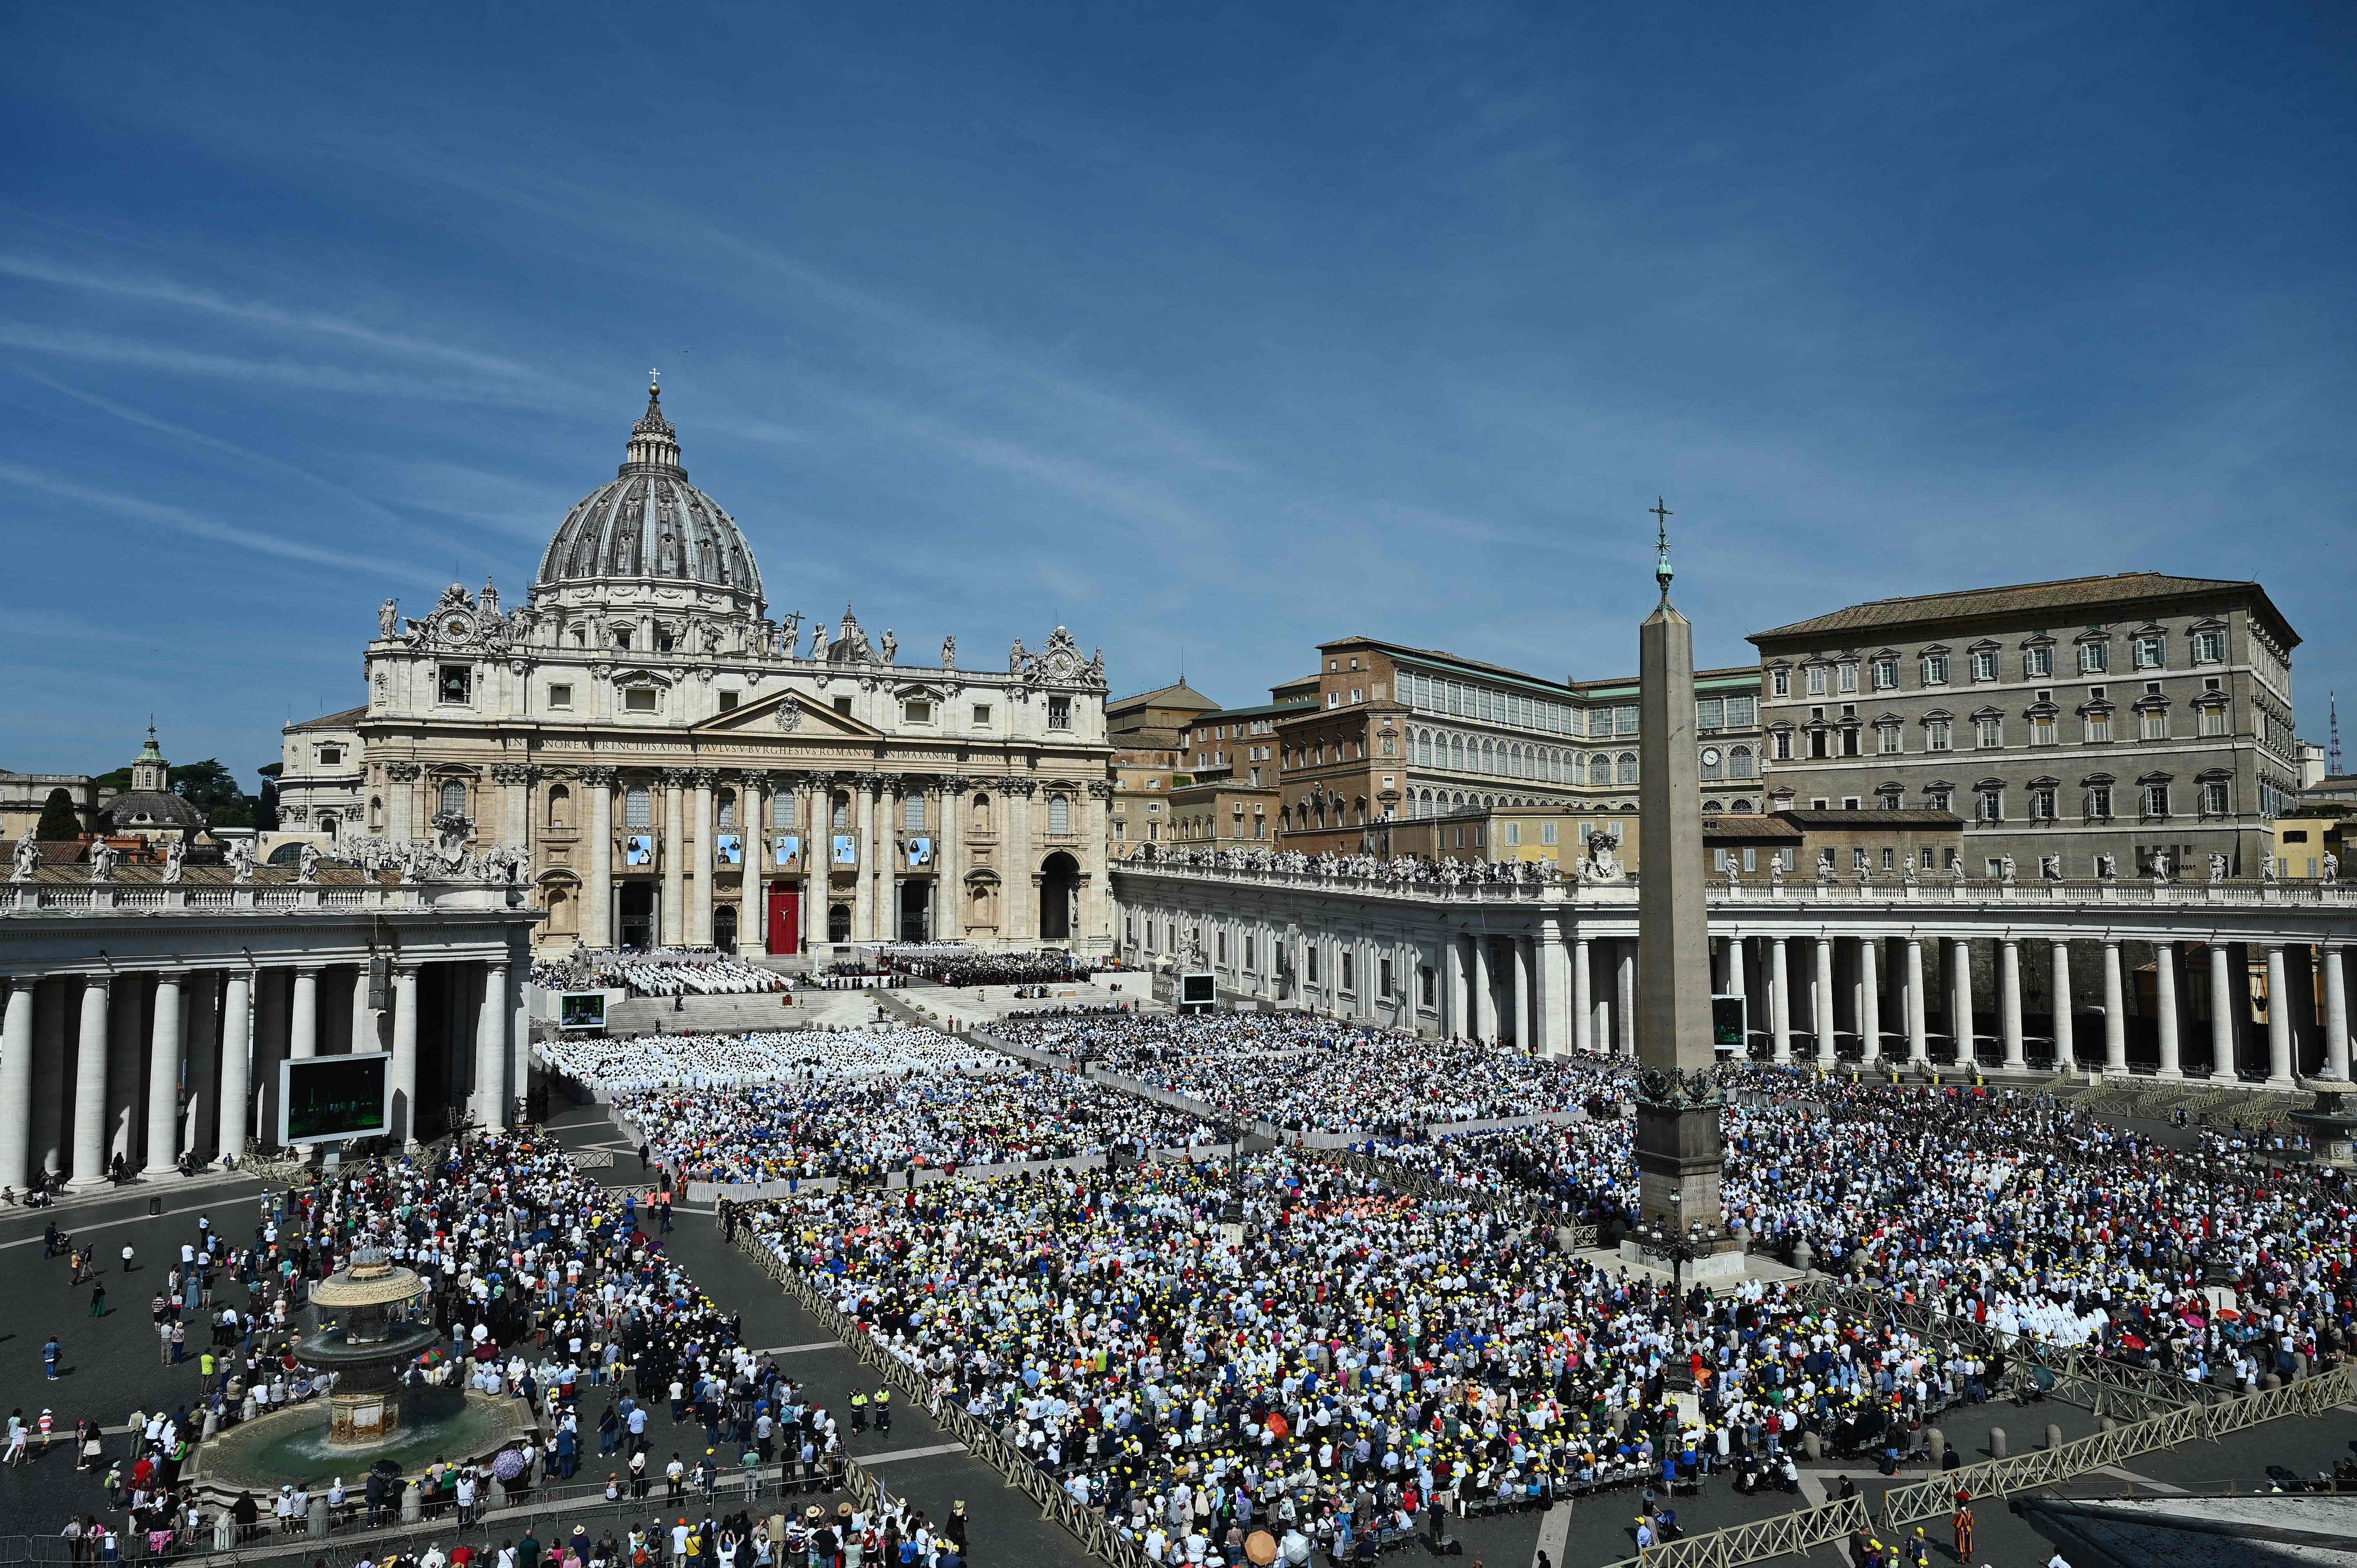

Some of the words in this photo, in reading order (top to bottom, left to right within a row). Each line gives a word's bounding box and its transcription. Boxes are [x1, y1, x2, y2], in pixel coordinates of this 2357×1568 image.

[508, 738, 522, 747] IN
[527, 739, 592, 750] HONOREM
[595, 741, 656, 751] PRINCIPIS
[698, 744, 737, 753] PAVLVS
[748, 745, 817, 755] BVRGHESIVS
[820, 748, 873, 757] ROMANVS
[875, 750, 900, 758] PONT
[902, 751, 924, 759] MAX
[926, 751, 939, 760] AN
[982, 754, 1006, 762] PONT
